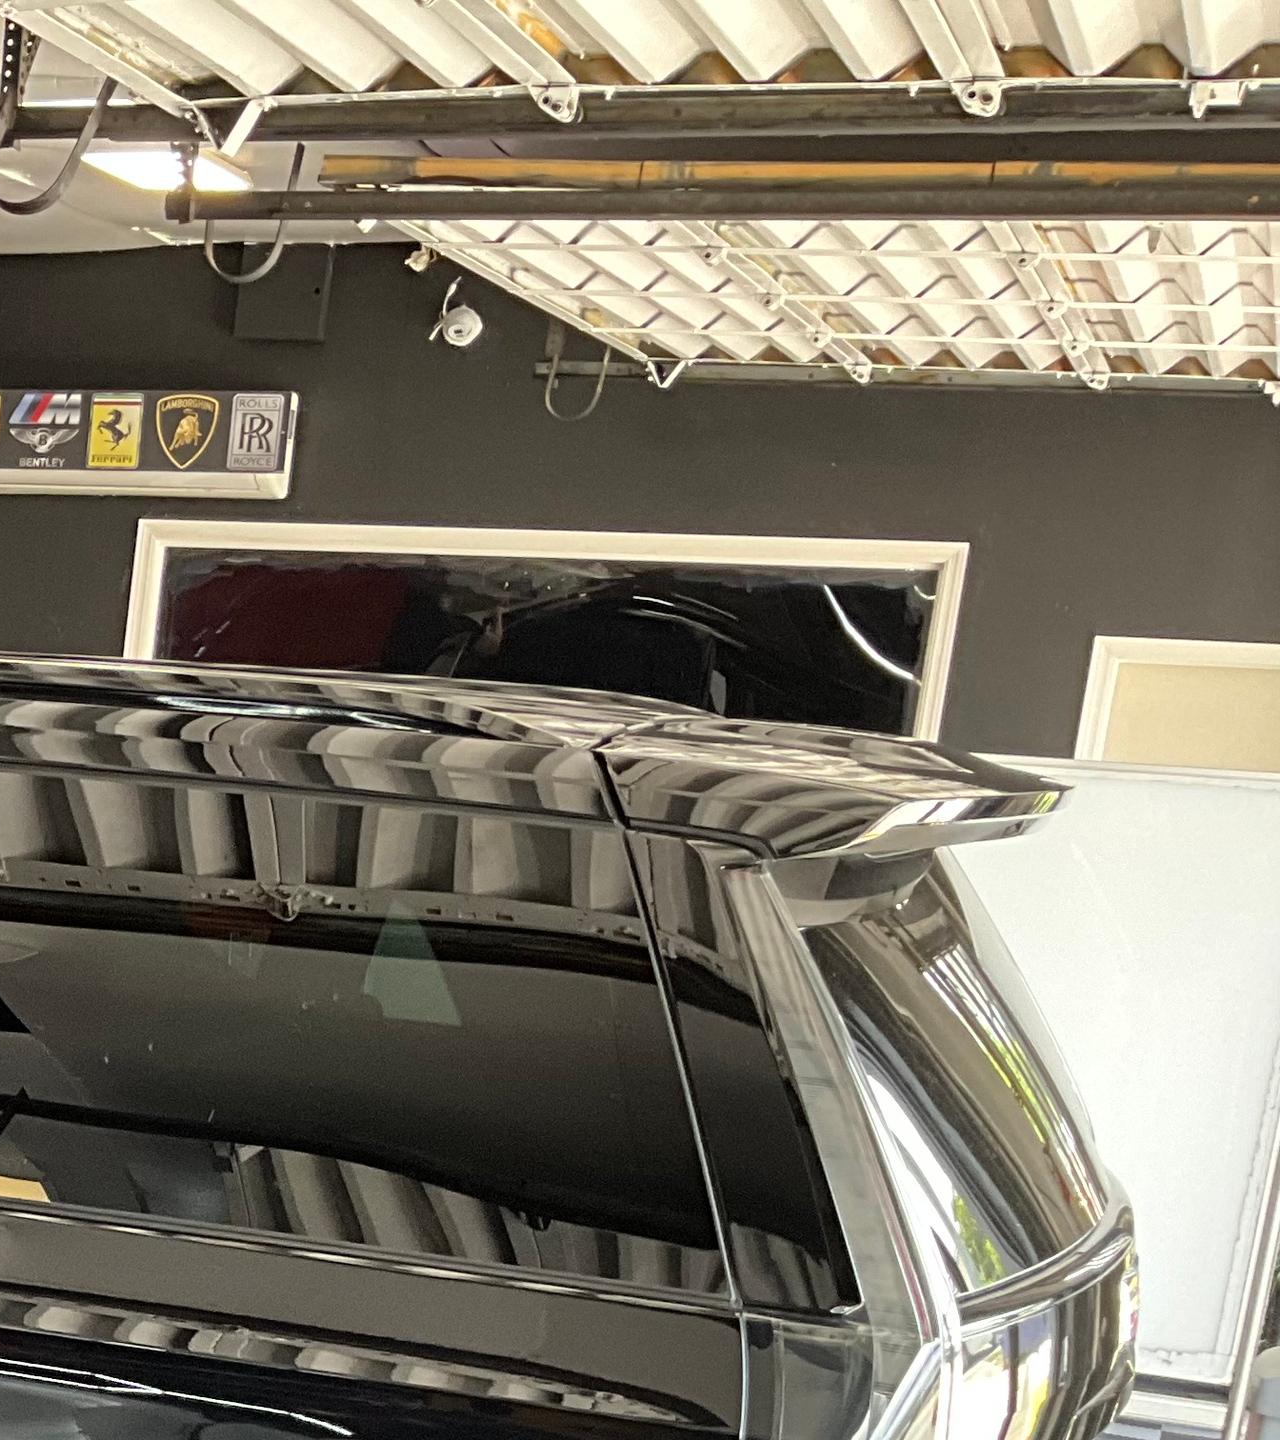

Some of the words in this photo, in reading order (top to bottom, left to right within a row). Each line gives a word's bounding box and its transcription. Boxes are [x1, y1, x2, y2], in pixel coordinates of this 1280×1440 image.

[161, 399, 214, 413] LAMBORGHINI
[239, 398, 279, 410] ROLLS
[19, 457, 66, 468] BENTLEY
[232, 456, 273, 468] ROYCE
